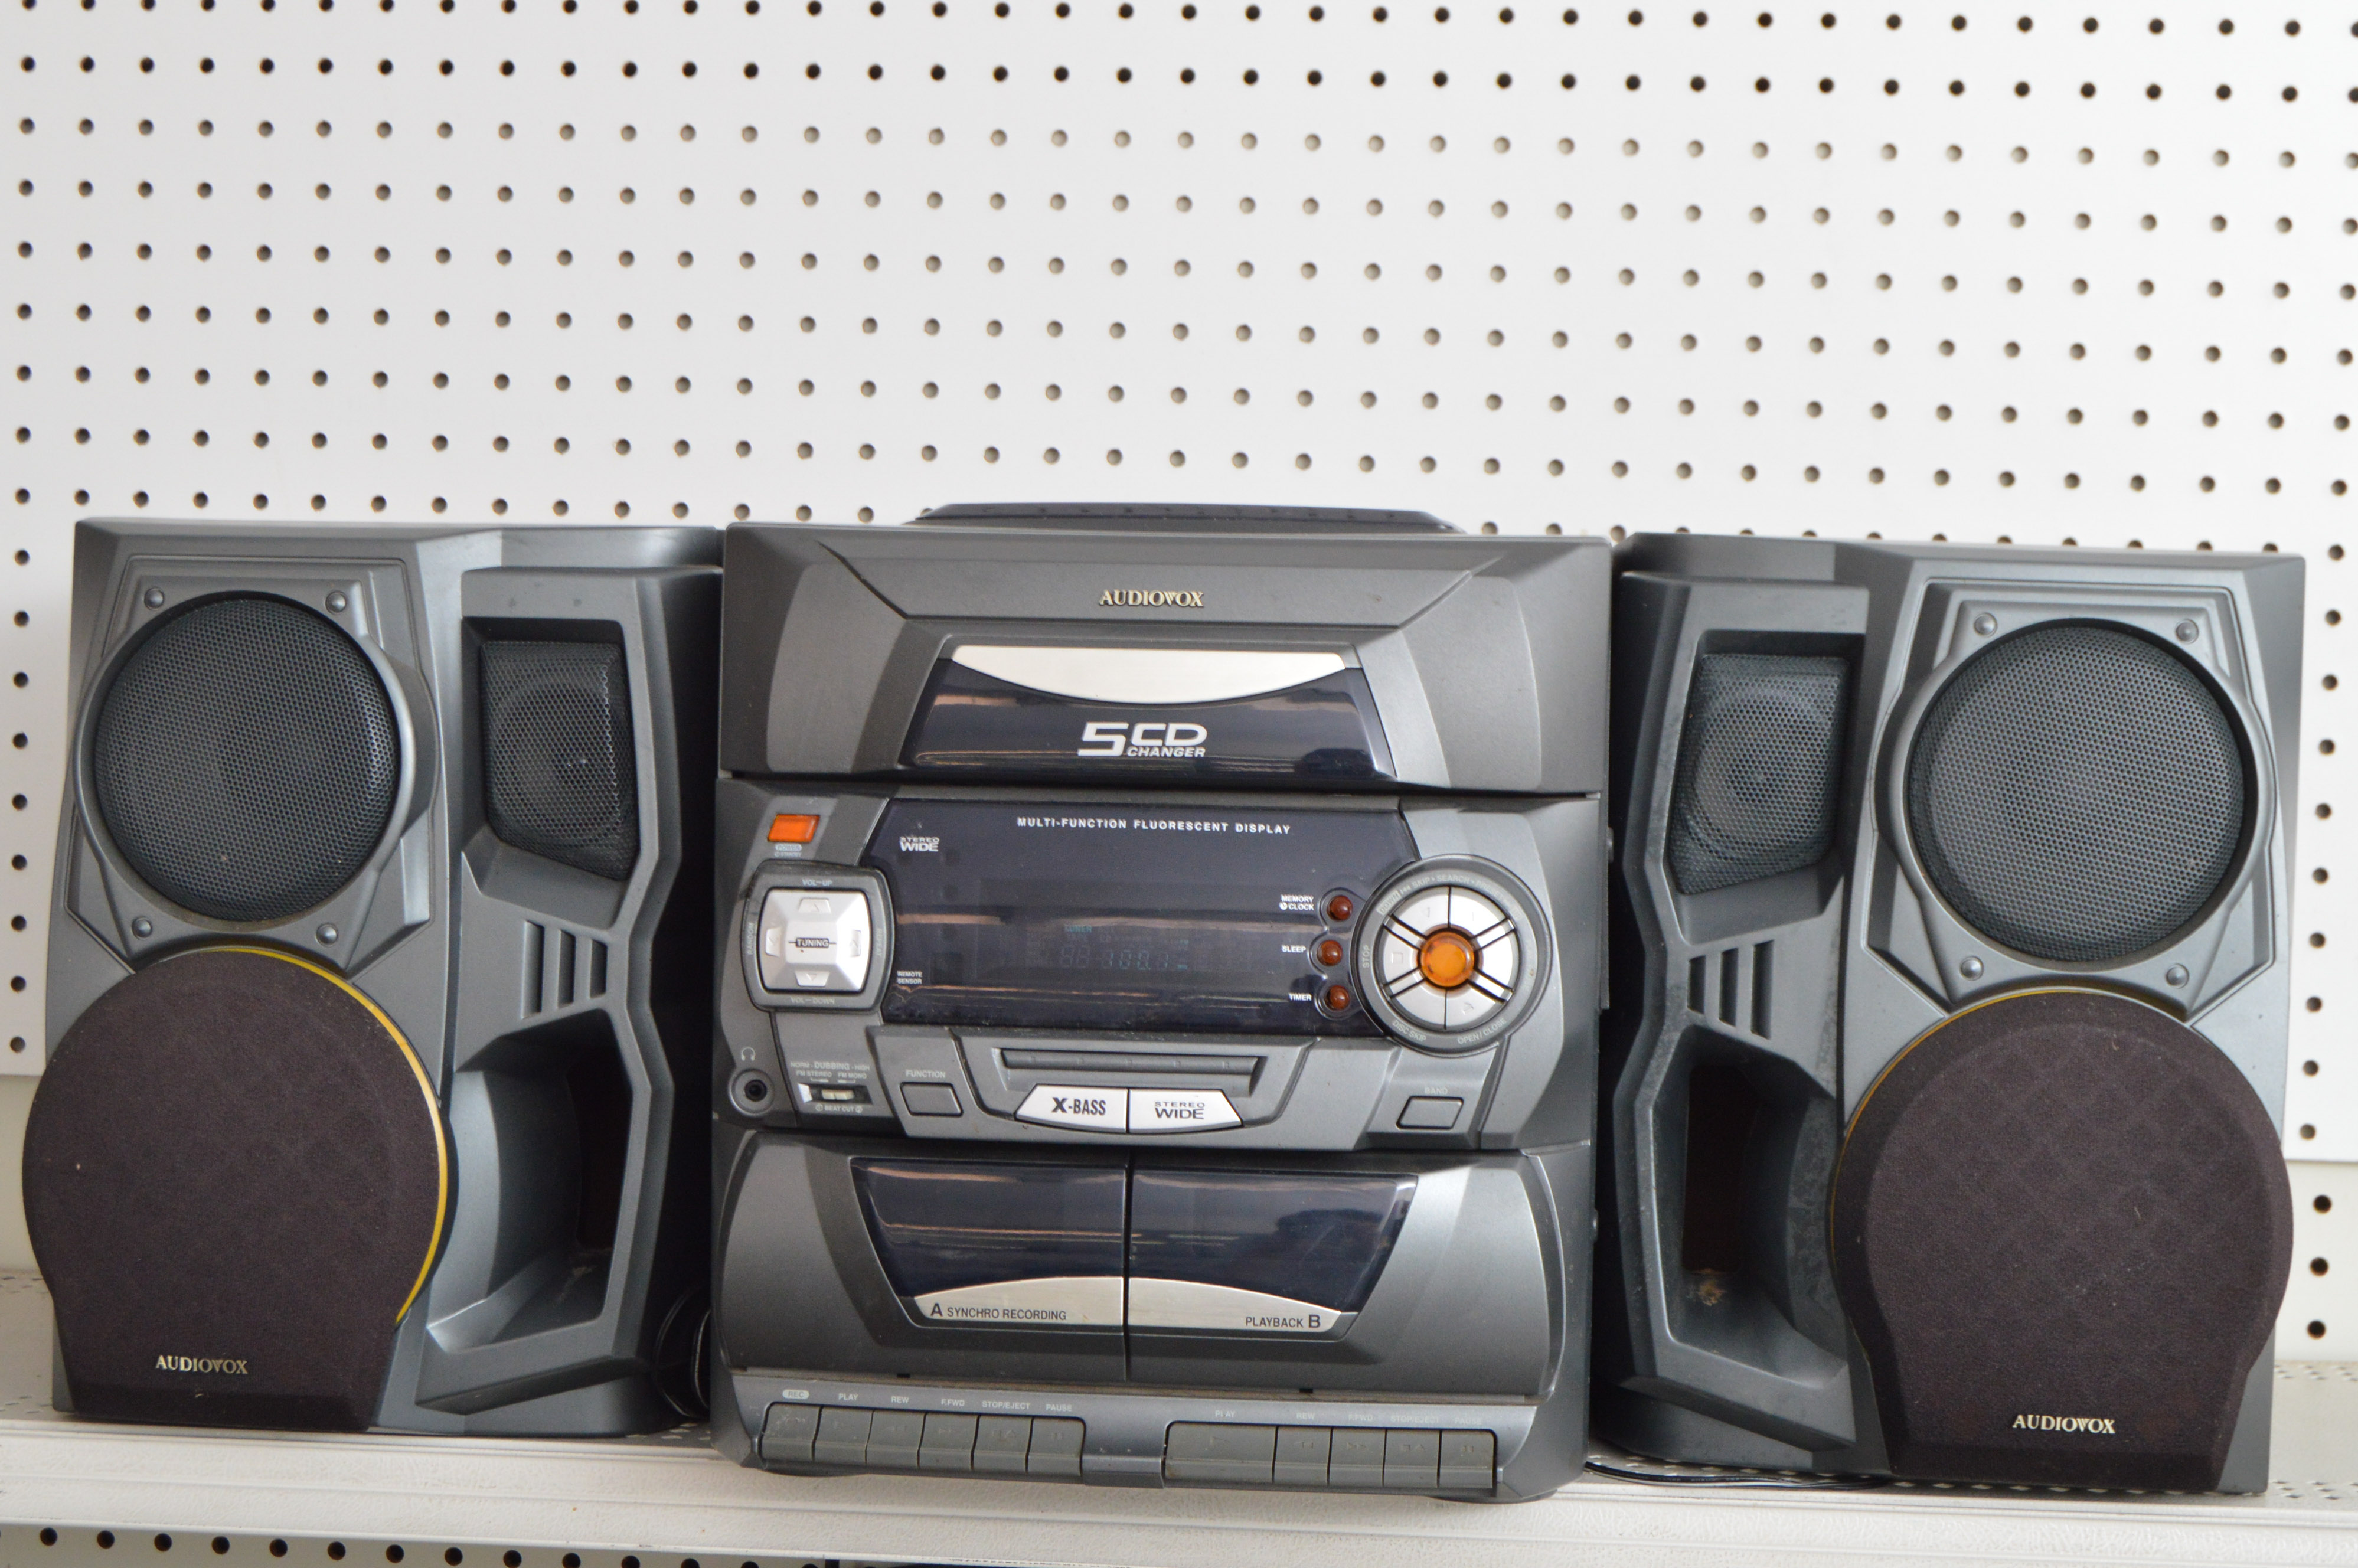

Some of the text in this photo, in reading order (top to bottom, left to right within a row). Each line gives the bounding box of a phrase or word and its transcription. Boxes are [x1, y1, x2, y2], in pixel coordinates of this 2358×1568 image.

[1099, 589, 1204, 607] AUDIOVOX
[1077, 721, 1208, 757] 5 CD
[1126, 746, 1206, 758] CHANGER
[1017, 816, 1291, 835] MULTI-FUNCTION FLUORESCENT DISPLAY
[899, 841, 939, 852] WIDE
[1412, 877, 1431, 889] SKIP
[1436, 874, 1471, 884] SEARCH
[1281, 894, 1314, 903] MEMORY
[1288, 903, 1314, 911] CLOCK
[747, 922, 755, 955] RANDOM
[796, 937, 829, 948] TUNING
[1281, 945, 1307, 953] SLEEP
[1362, 945, 1370, 968] STOP
[1288, 992, 1312, 1001] TIMER
[1392, 1020, 1428, 1043] DISC SKIP
[814, 1061, 850, 1070] DUBBING
[905, 1069, 946, 1079] FUNCTION
[1425, 1087, 1448, 1095] BAND
[1051, 1097, 1106, 1116] X-BASS
[1155, 1107, 1205, 1119] WIDE
[930, 1302, 1067, 1321] A SYNCHRO RECORDING
[1245, 1314, 1321, 1329] PLAYBACK B
[155, 1354, 249, 1374] AUDIOVOX
[787, 1390, 805, 1399] REC
[838, 1393, 858, 1401] PLAY
[890, 1395, 909, 1404] REW
[940, 1398, 965, 1407] F.FWD
[982, 1400, 1031, 1410] STOP/EJECT
[1046, 1403, 1073, 1412] PAUSE
[1214, 1409, 1236, 1418] PLAY
[2011, 1414, 2116, 1435] AUDIOVOX
